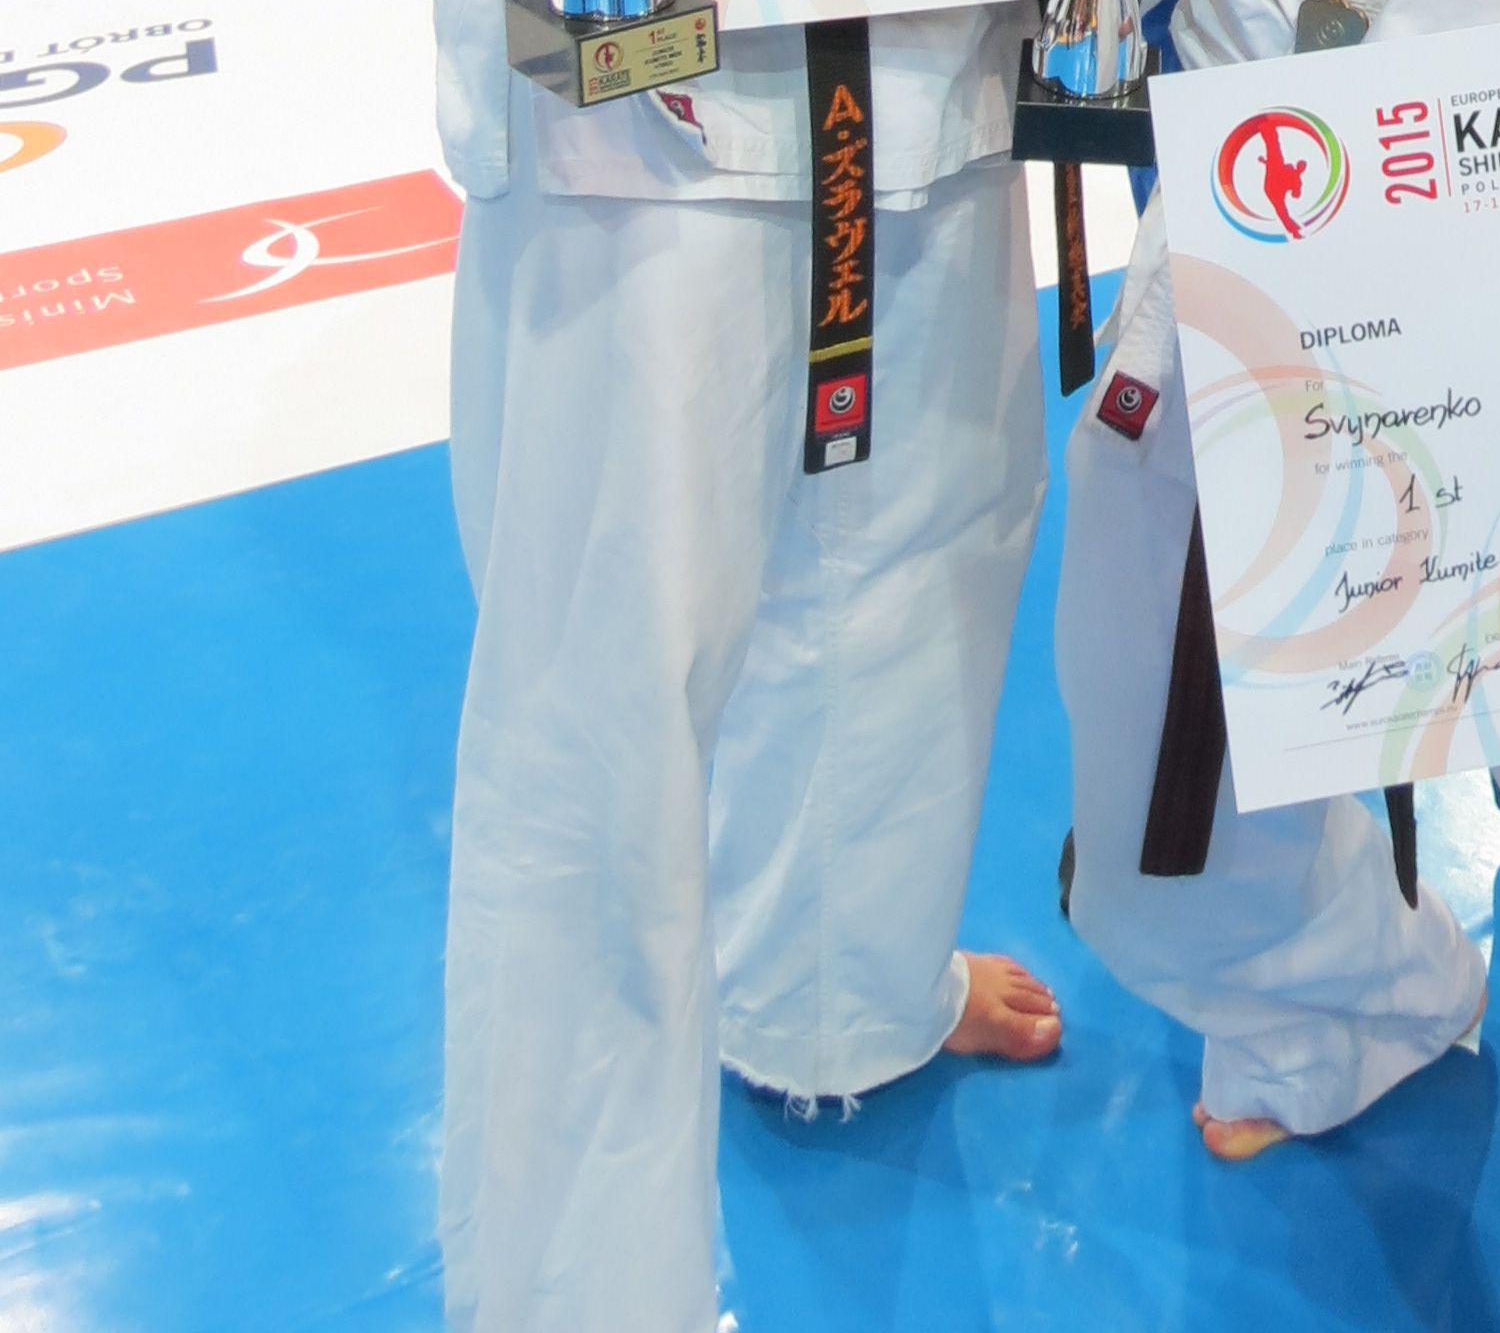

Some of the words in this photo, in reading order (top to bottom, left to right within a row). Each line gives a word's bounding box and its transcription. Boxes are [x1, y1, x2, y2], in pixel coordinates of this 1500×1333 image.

[37, 18, 213, 59] OBRÓT
[1376, 100, 1438, 206] 2015
[0, 266, 124, 304] Spor
[1300, 318, 1402, 351] DIPLOMA
[1305, 380, 1325, 393] For
[1304, 387, 1482, 446] Svynarenko
[1314, 461, 1331, 475] for
[1335, 453, 1384, 472] winning
[1387, 449, 1408, 466] the
[1324, 538, 1357, 557] place
[1361, 536, 1374, 549] in
[1376, 527, 1430, 547] category
[1335, 570, 1403, 613] Junior
[1419, 552, 1500, 584] Kumite
